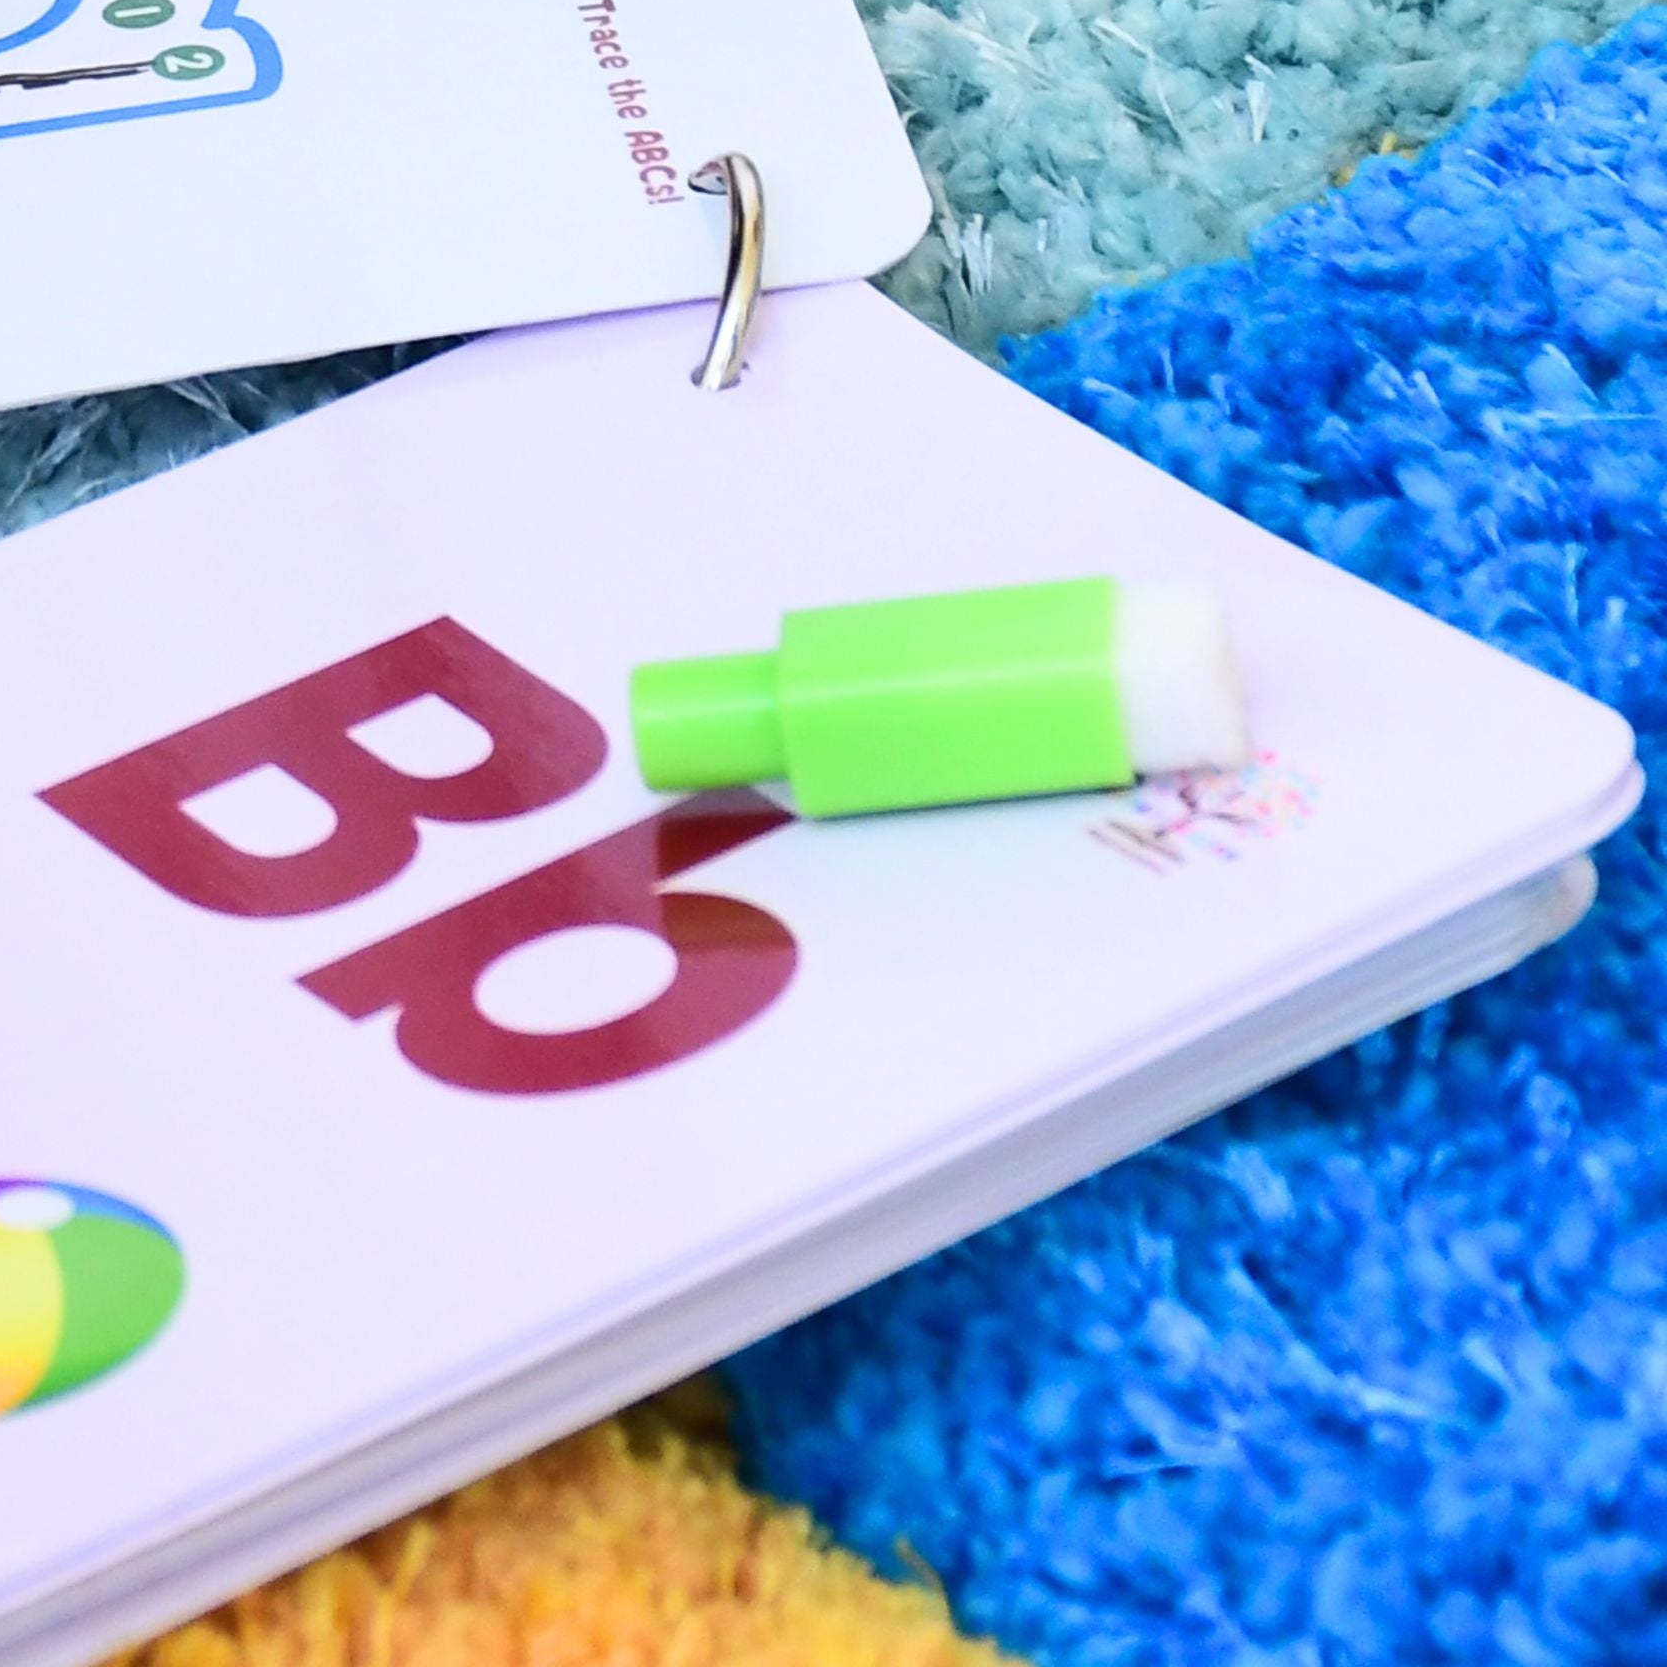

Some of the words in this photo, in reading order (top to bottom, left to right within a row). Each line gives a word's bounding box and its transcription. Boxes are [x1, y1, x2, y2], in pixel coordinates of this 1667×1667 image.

[606, 78, 648, 120] the
[624, 129, 685, 206] ABCs!
[33, 614, 801, 1099] Bb
